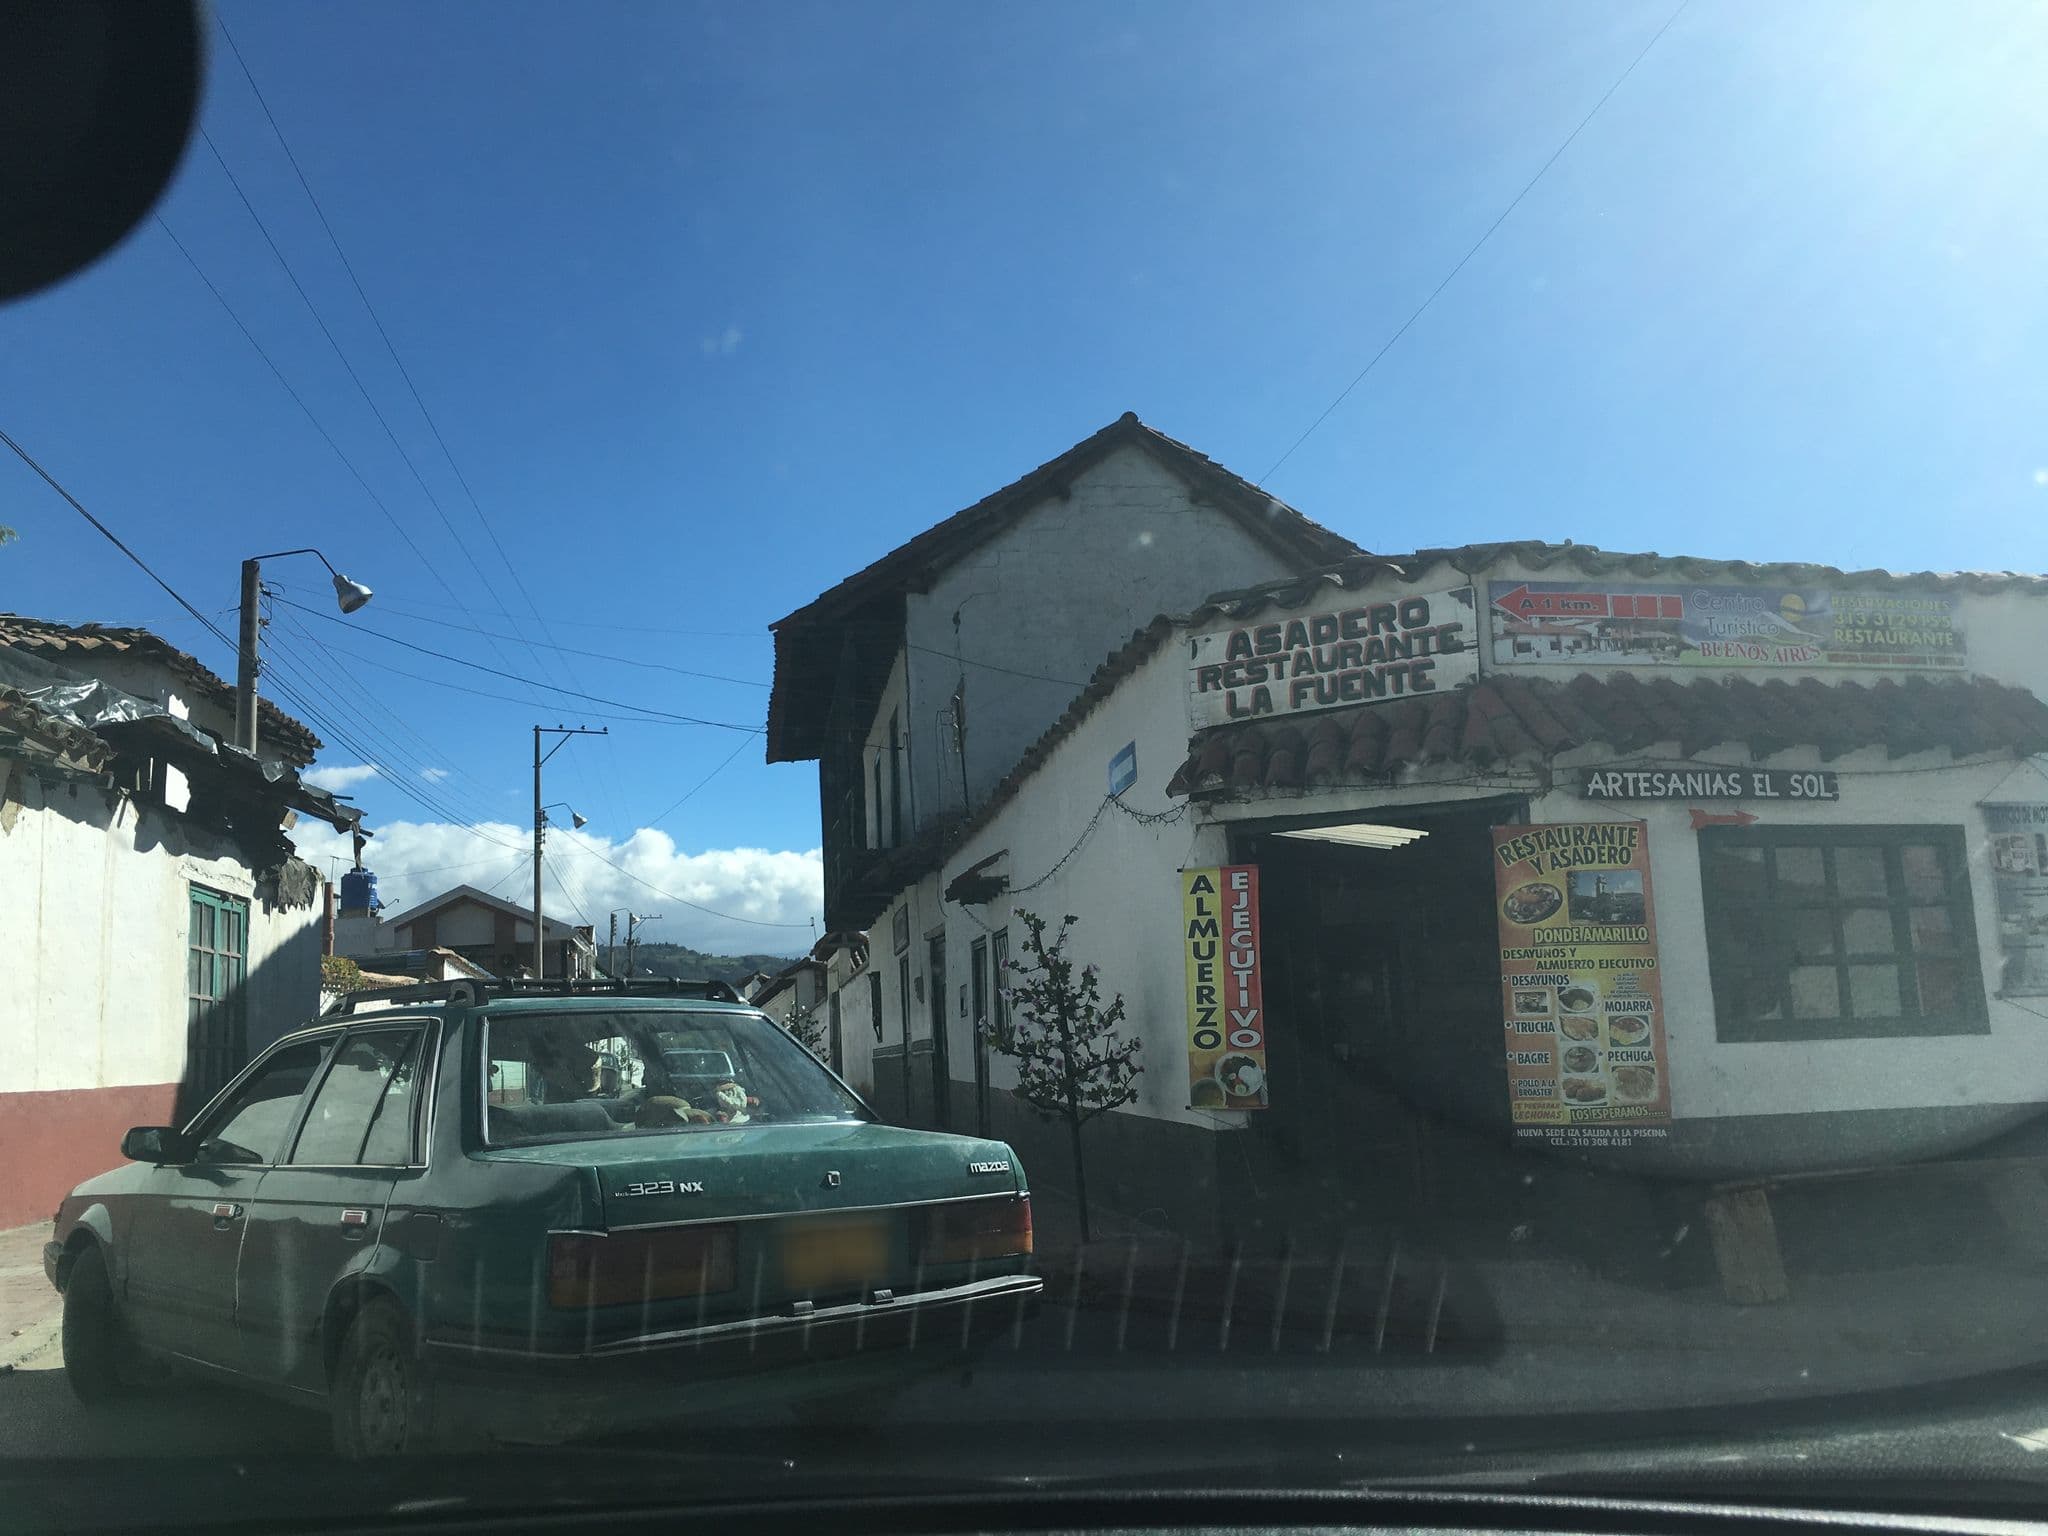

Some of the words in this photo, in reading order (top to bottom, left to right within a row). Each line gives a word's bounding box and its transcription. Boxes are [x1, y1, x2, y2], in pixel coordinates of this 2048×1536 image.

[1691, 589, 1765, 612] Centro
[1834, 610, 1866, 625] 313
[1226, 596, 1430, 661] ASADERO
[1834, 629, 1952, 646] RESTAURANTE
[1197, 622, 1464, 692] RESTAURANTE
[1700, 641, 1769, 661] BUENOS
[1775, 644, 1822, 663] AIRES
[1226, 684, 1273, 718] LA
[1289, 658, 1436, 709] FUENTE
[1587, 772, 1742, 797] ARTESANIAS
[1754, 773, 1779, 797] EL
[1790, 774, 1834, 798] SOL
[1497, 826, 1639, 867] RESTAURANTE
[1529, 856, 1544, 875] Y
[1551, 846, 1632, 871] ASADERO
[1534, 928, 1580, 943] DONDE
[1582, 926, 1649, 943] AMARILLO
[1229, 872, 1262, 1048] EJECUTIVO
[1503, 947, 1566, 960] DESAYUNOS
[1569, 948, 1577, 957] Y
[1187, 875, 1222, 1050] ALMUERZO
[1536, 959, 1595, 970] ALMUERZO
[1599, 959, 1655, 969] EJECUTIVO
[1512, 975, 1570, 986] DESAYUNOS
[1605, 1000, 1654, 1012] MOJARRA
[1515, 1022, 1556, 1033] TRUCHA
[1518, 1052, 1550, 1064] BAGRE
[1608, 1051, 1655, 1062] PECHUGA
[1518, 1079, 1539, 1087] POLLO
[1518, 1088, 1553, 1096] BROASTER
[1514, 1111, 1563, 1120] LECHONAS
[1571, 1109, 1589, 1120] LOS
[1517, 1129, 1544, 1137] NUEVA
[1545, 1129, 1564, 1137] SEDE
[1567, 1129, 1580, 1137] IZA
[1582, 1129, 1611, 1137] SALIDA
[1613, 1129, 1620, 1137] A
[1621, 1129, 1631, 1137] LA
[1633, 1129, 1668, 1137] PISCINA
[1573, 1138, 1589, 1146] 310
[970, 1161, 1010, 1173] mazda
[628, 1180, 675, 1196] 323
[679, 1181, 704, 1193] NX
